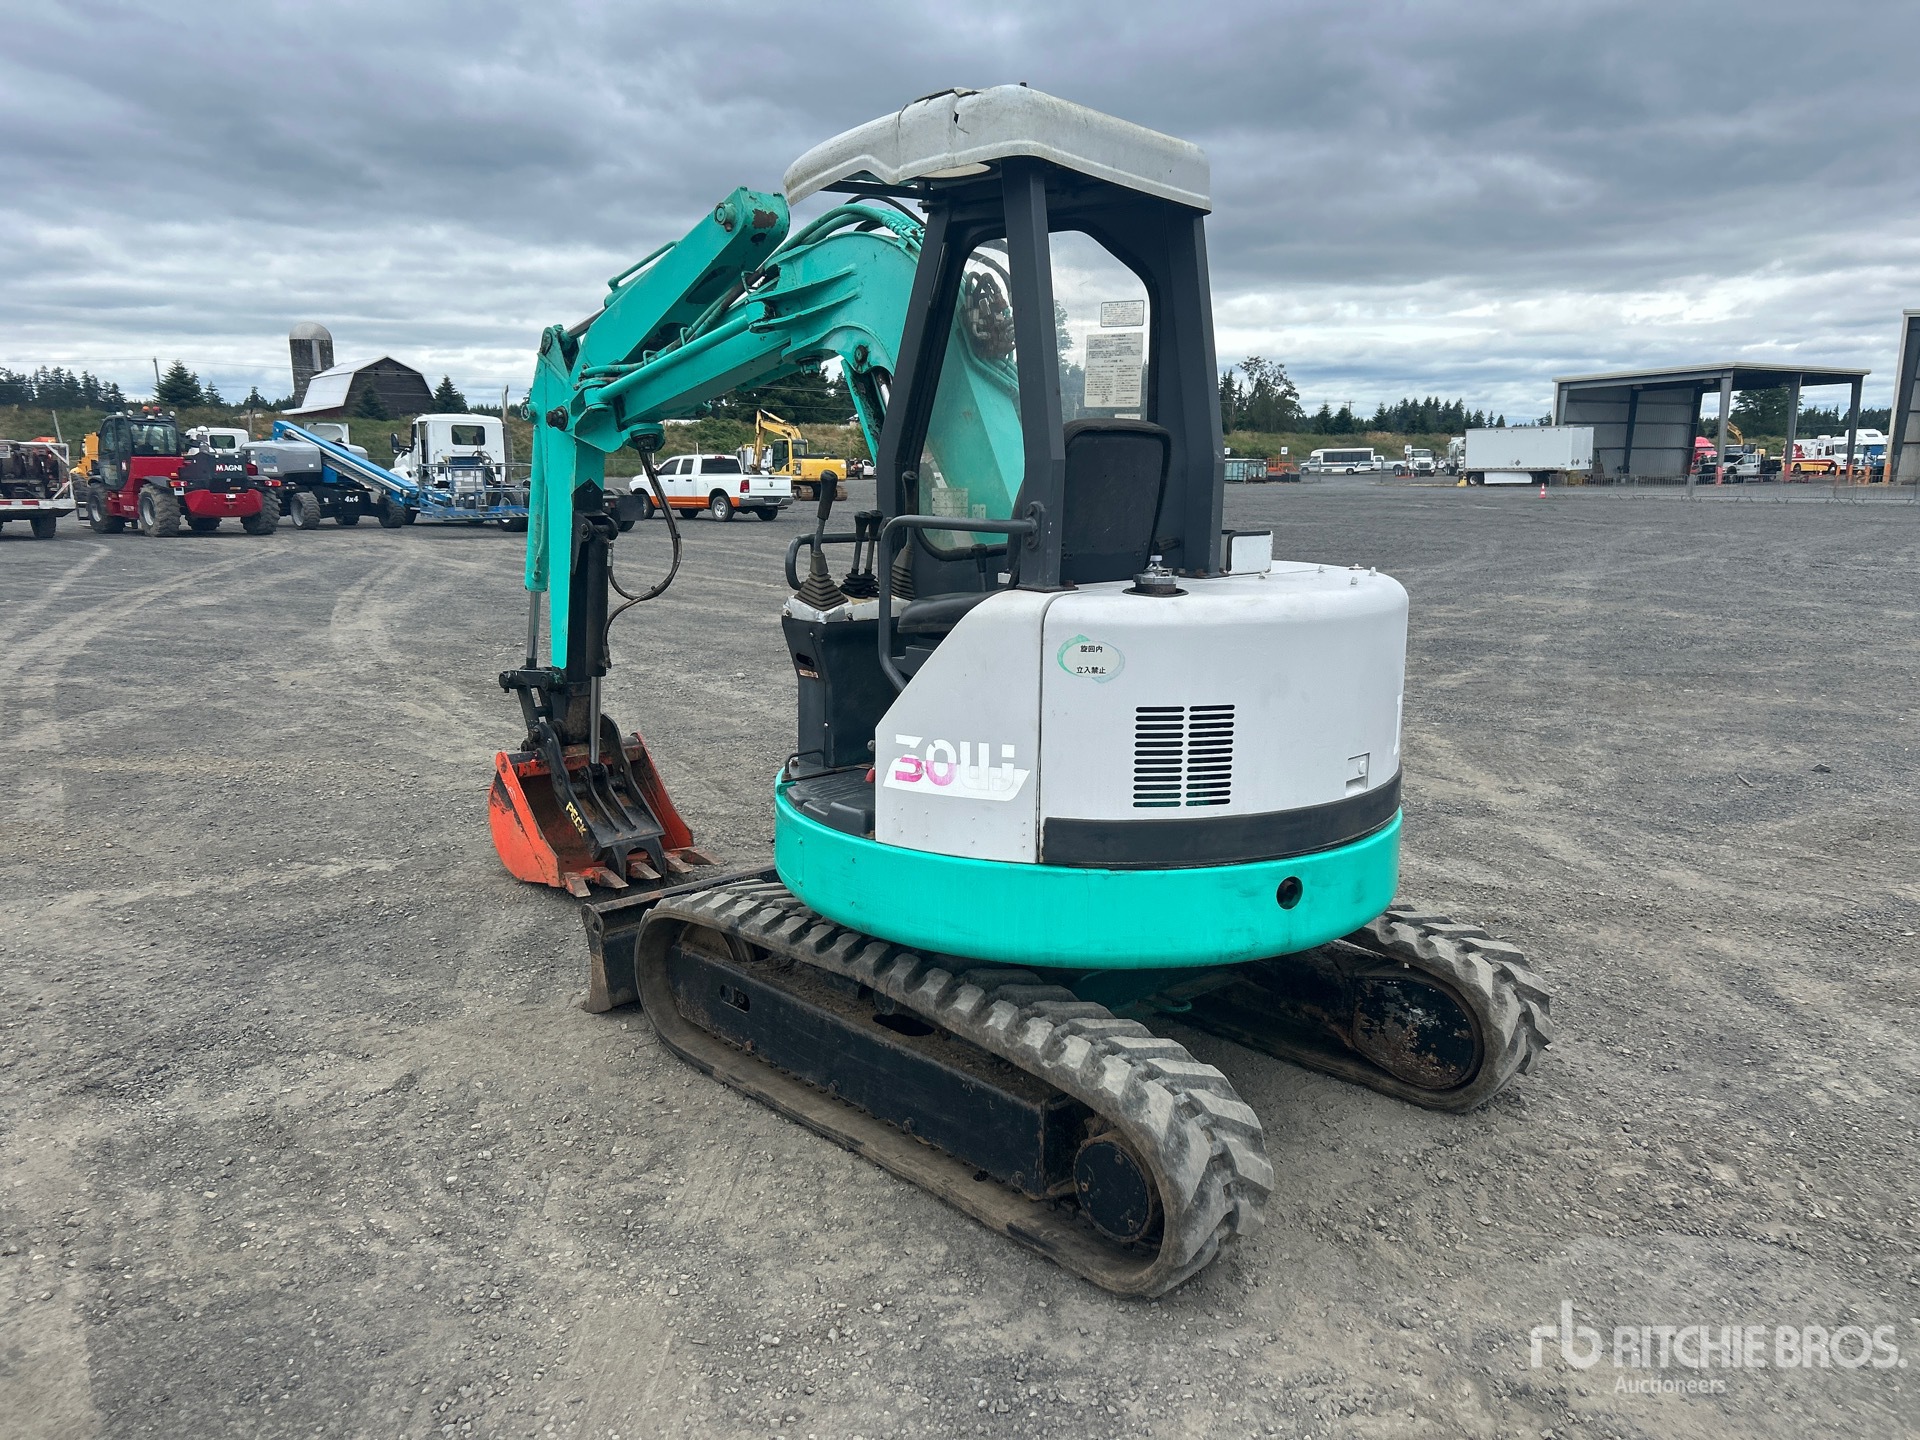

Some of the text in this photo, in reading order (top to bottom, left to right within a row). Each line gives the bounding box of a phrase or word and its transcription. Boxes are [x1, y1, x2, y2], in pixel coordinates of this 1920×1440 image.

[216, 464, 243, 472] MAGNI
[344, 495, 359, 503] 4x4
[1080, 645, 1103, 653] 旋回内
[1076, 666, 1106, 674] 立入禁止
